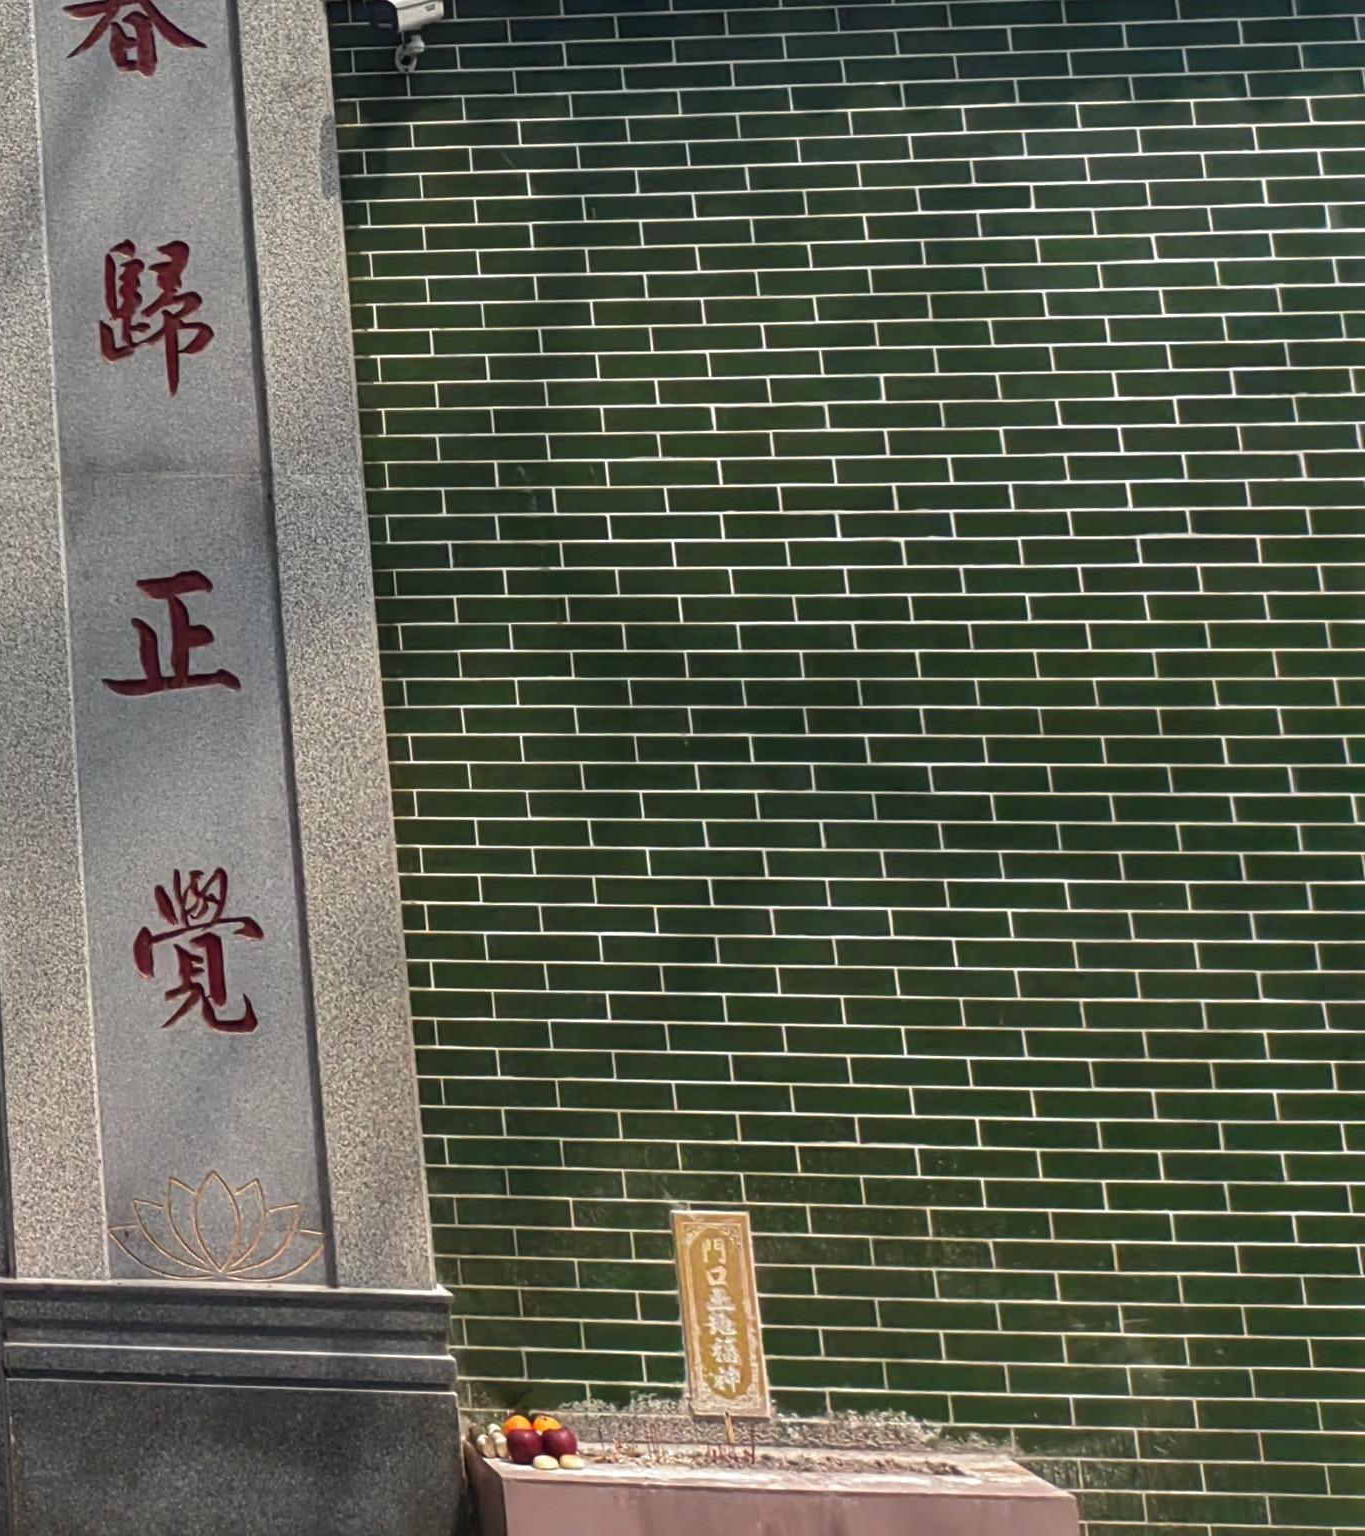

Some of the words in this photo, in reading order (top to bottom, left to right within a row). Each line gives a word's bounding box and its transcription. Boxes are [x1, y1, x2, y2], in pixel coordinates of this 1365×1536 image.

[701, 1237, 742, 1395] 門口土地福神
